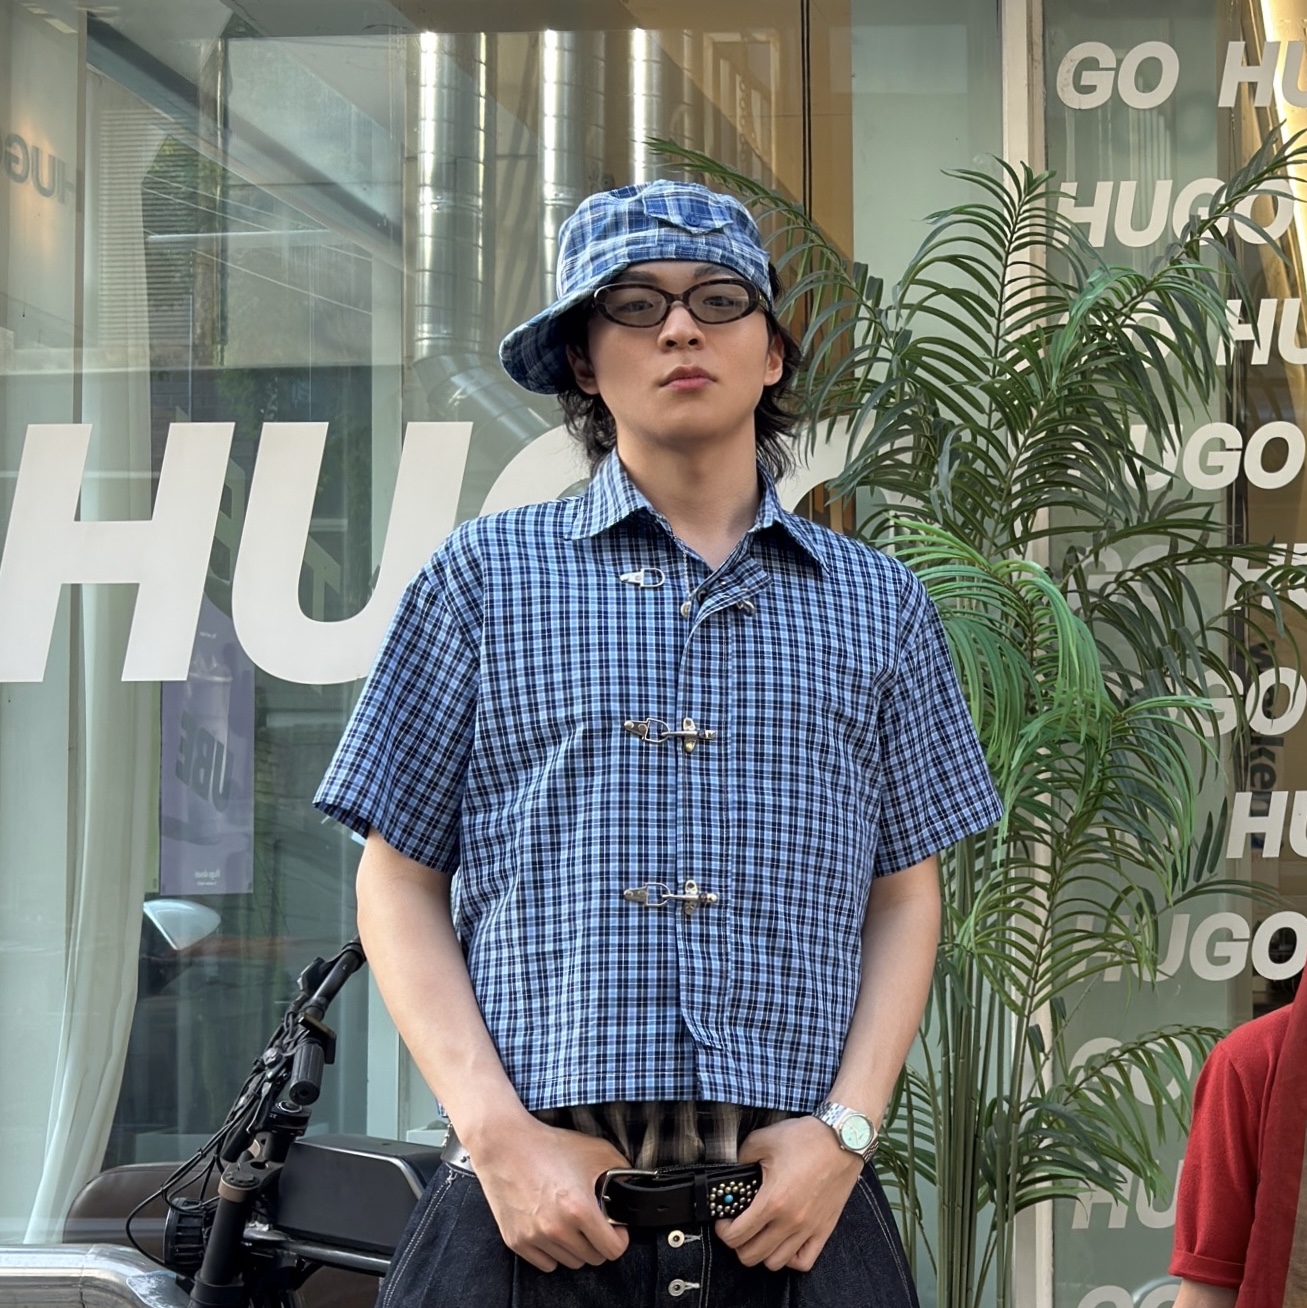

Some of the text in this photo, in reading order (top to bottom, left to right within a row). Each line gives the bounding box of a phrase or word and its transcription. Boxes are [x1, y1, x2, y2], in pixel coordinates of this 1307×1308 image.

[1056, 41, 1179, 110] GO
[1090, 420, 1306, 490] UGO
[0, 422, 580, 684] HU
